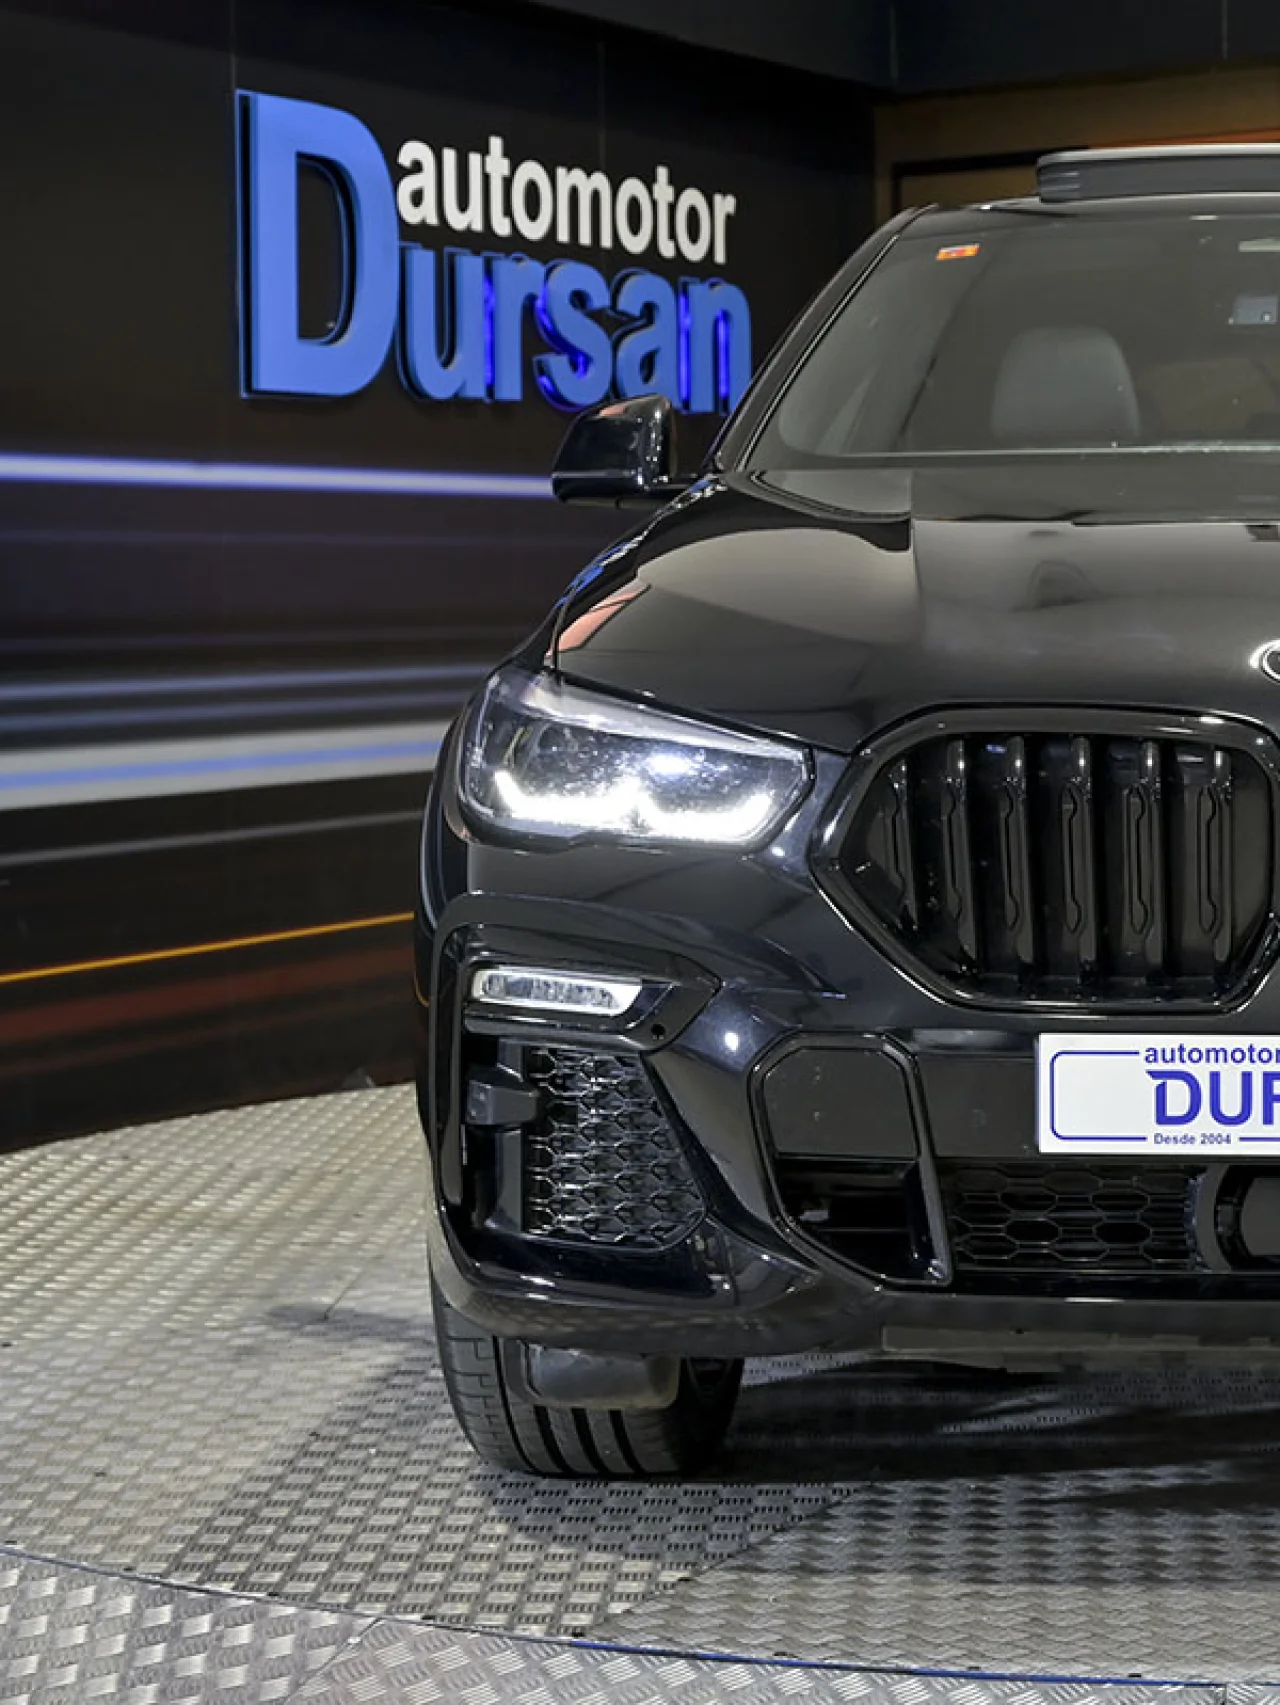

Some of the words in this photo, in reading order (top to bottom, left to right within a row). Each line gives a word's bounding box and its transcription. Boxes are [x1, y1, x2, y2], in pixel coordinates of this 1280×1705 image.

[235, 88, 753, 415] Dursan
[397, 136, 736, 265] automotor
[1153, 1132, 1196, 1145] Desde
[1200, 1132, 1232, 1145] 2004
